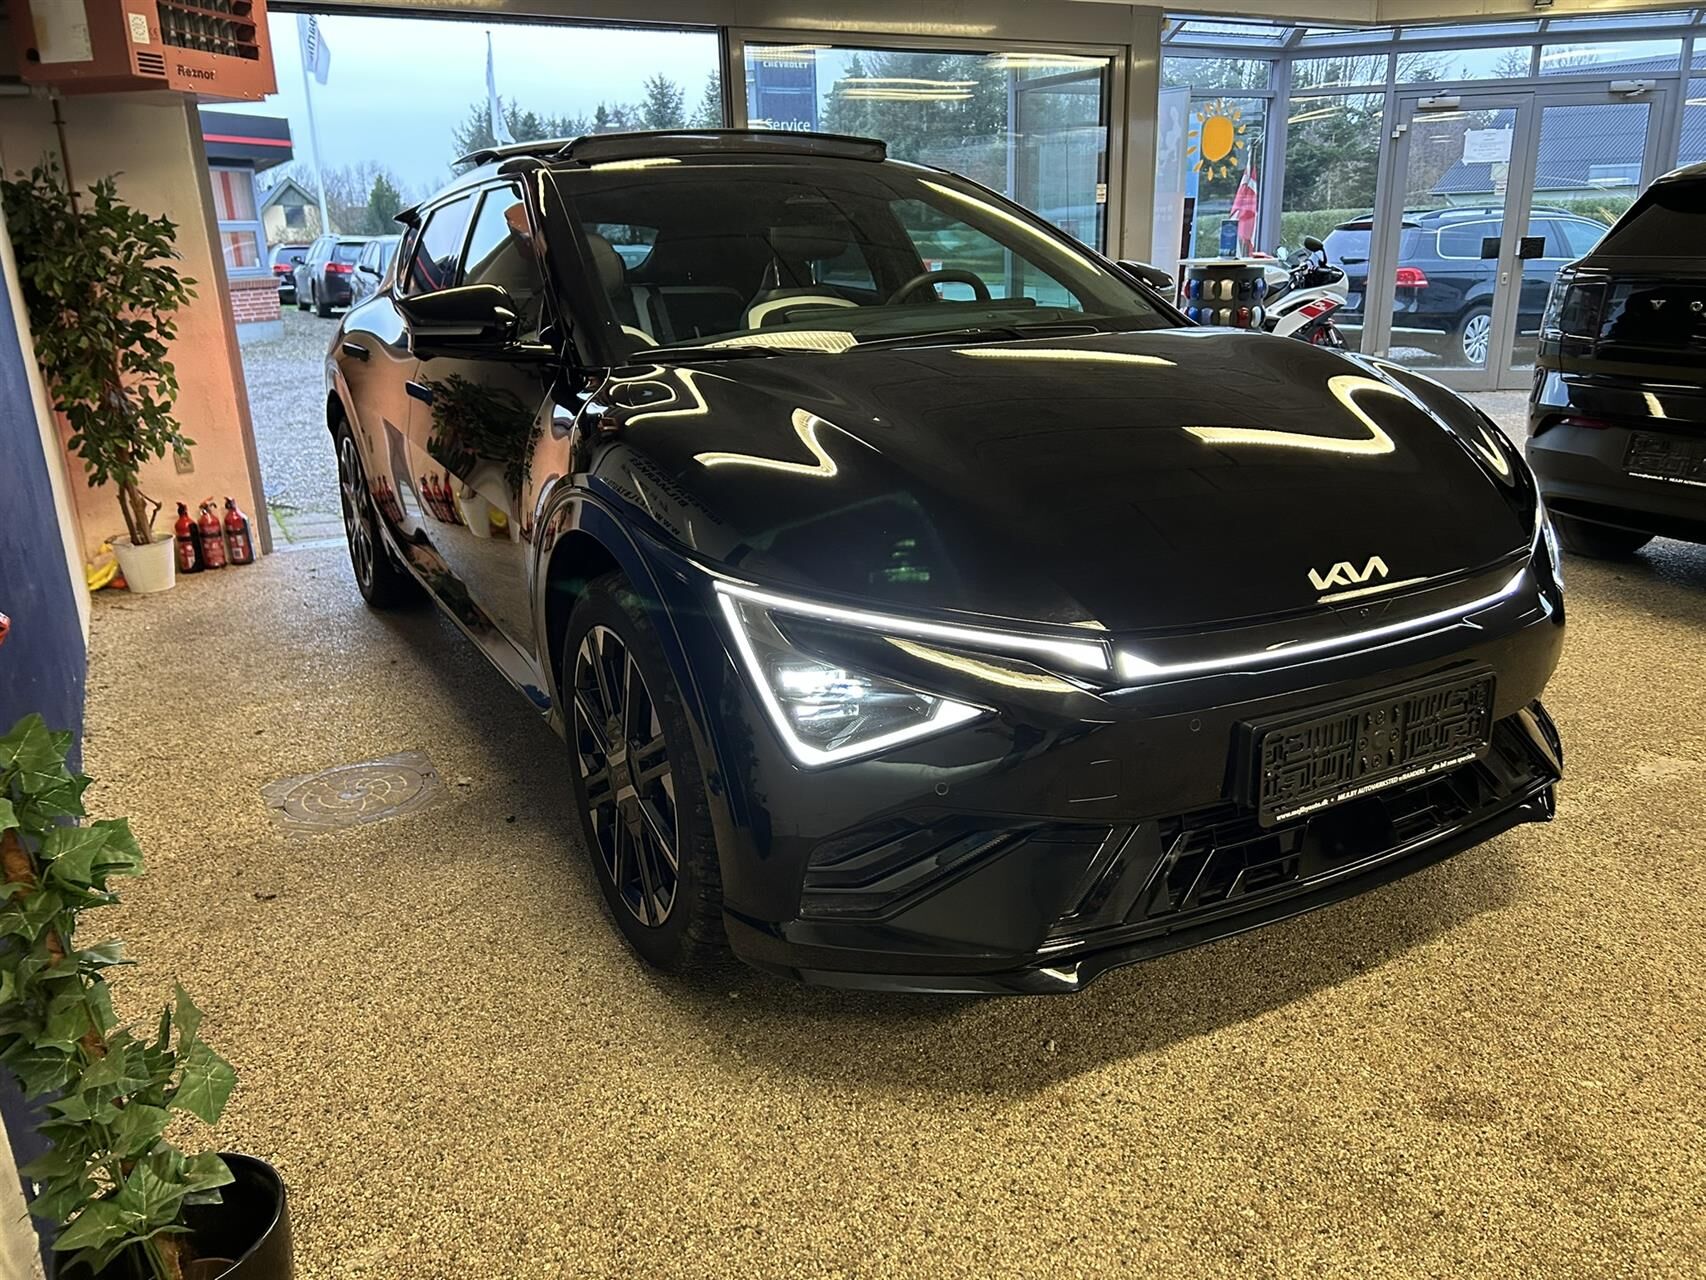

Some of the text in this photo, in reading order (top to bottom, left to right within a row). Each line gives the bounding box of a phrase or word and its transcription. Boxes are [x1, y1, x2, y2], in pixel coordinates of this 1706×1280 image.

[763, 61, 809, 69] CHEVROLET
[766, 118, 811, 132] Service
[1308, 556, 1389, 590] KIA
